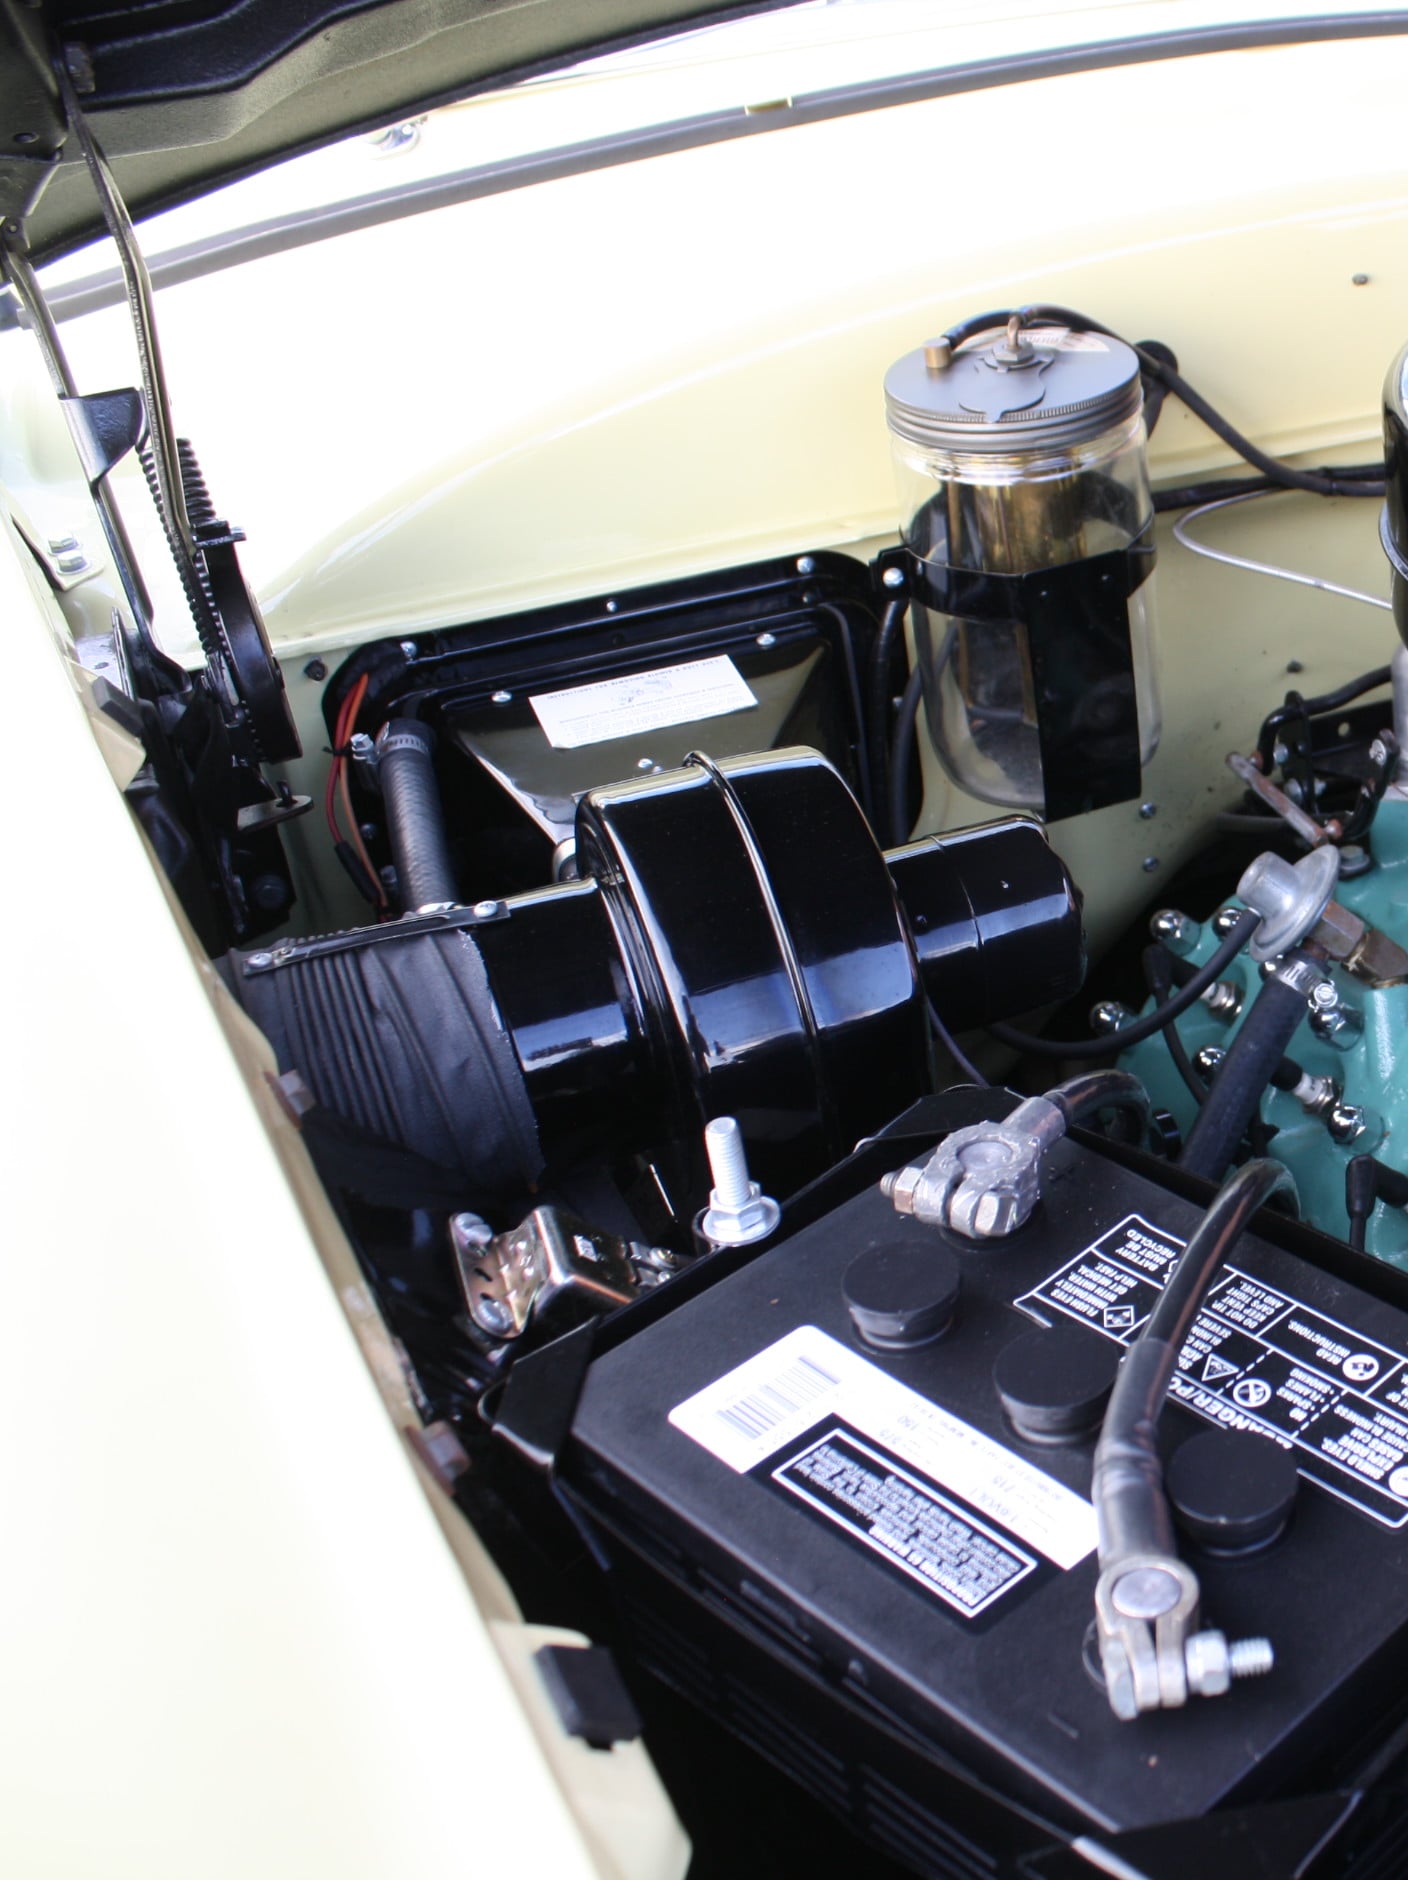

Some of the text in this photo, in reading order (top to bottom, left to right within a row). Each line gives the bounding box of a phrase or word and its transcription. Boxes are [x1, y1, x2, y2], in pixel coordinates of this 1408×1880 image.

[1126, 1229, 1176, 1259] RECYCLED
[1138, 1247, 1168, 1266] MUST
[1115, 1247, 1159, 1272] BATTERY
